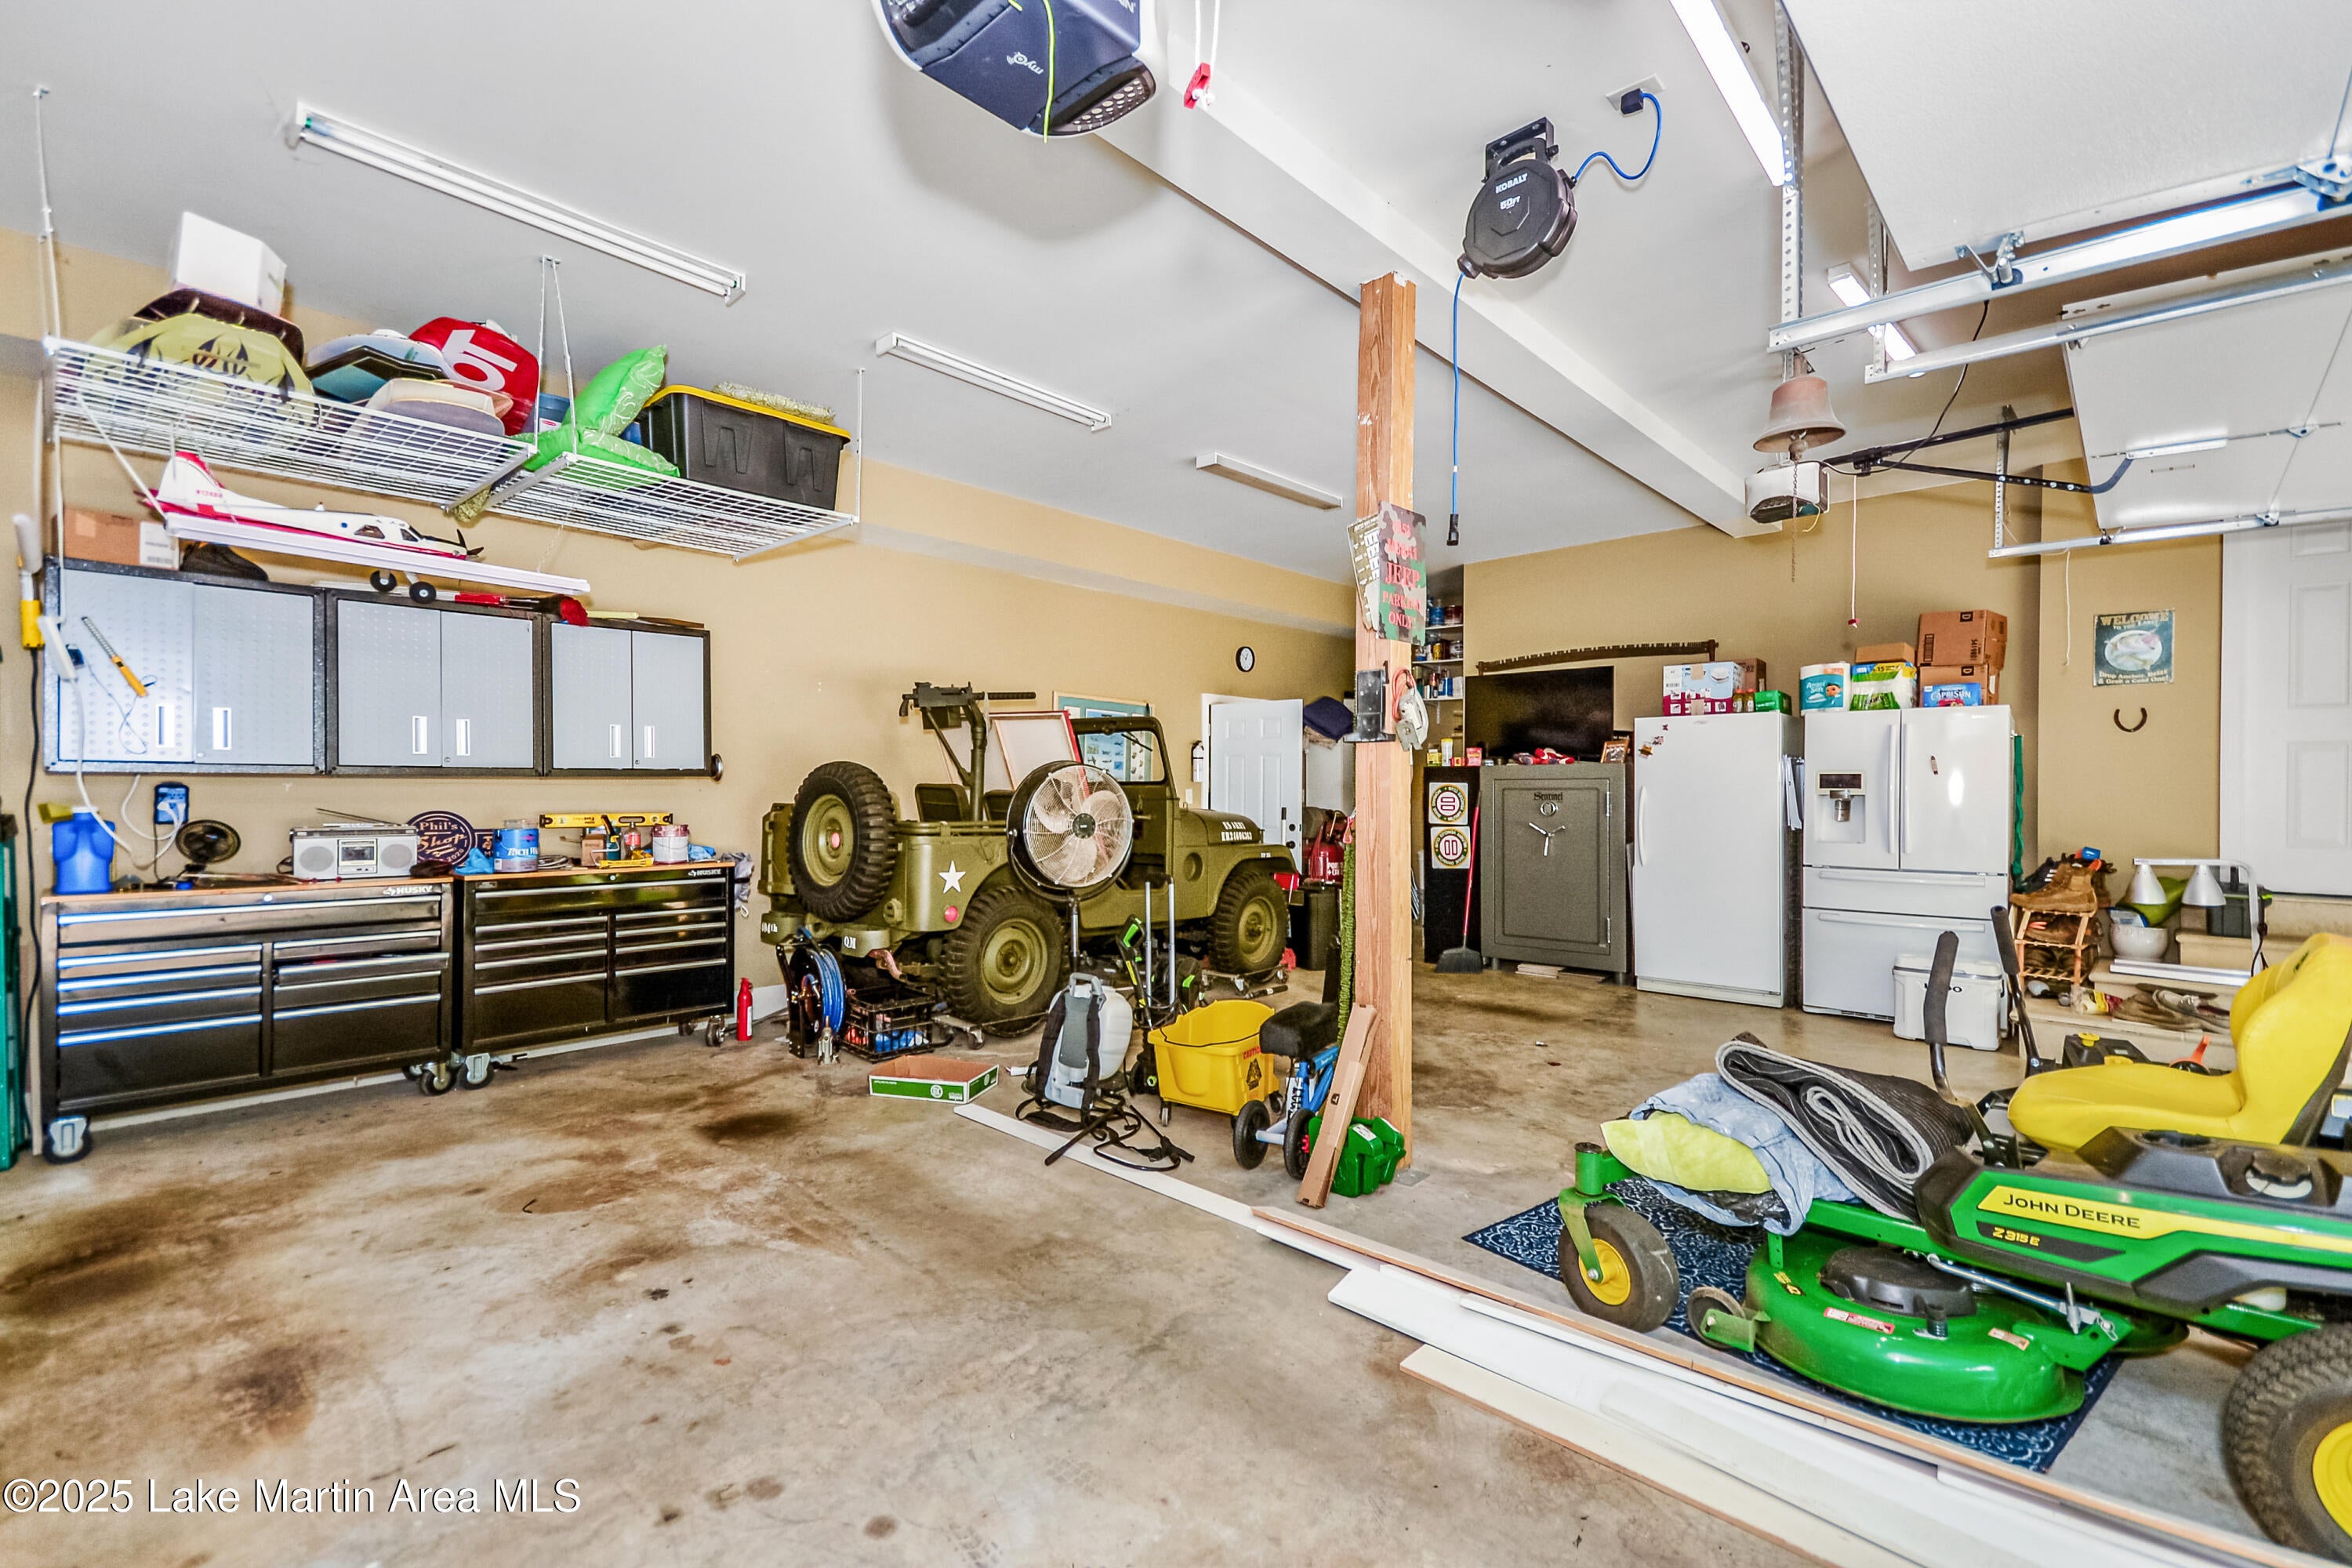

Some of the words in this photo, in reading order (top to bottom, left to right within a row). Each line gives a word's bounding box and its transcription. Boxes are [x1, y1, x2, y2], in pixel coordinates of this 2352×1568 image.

[1495, 172, 1528, 194] KOBALT
[1385, 562, 1421, 588] JEEP
[1382, 590, 1421, 613] PARKING
[2100, 611, 2169, 626] WELCOME
[2099, 670, 2116, 679] Drop
[419, 822, 458, 831] Phil's
[417, 833, 467, 851] Shop
[447, 848, 465, 862] 2020
[395, 884, 434, 895] HUSKY
[844, 935, 857, 949] QM
[2003, 1194, 2059, 1214] JOHN
[2065, 1203, 2140, 1229] DEERE
